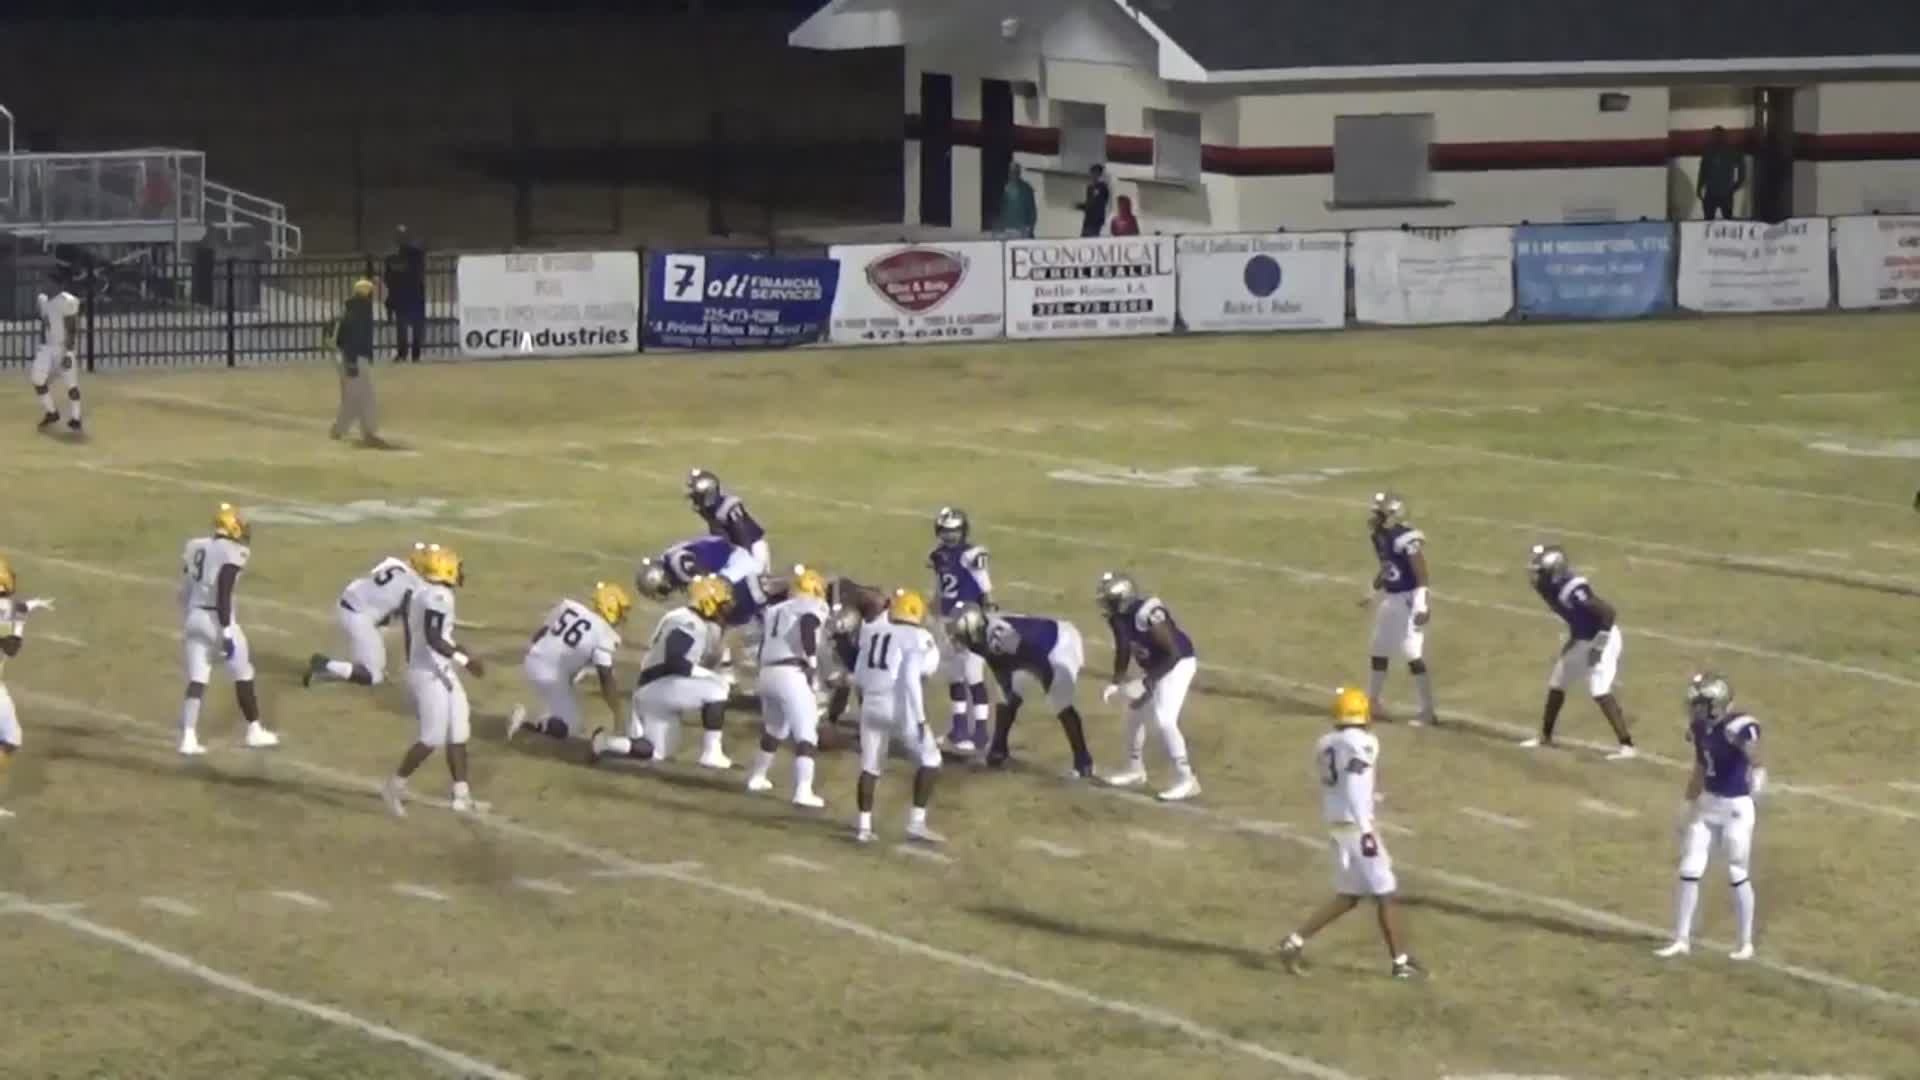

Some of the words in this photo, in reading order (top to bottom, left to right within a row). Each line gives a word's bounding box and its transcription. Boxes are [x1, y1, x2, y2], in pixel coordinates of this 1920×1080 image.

[1009, 243, 1172, 280] ECONOMICAL
[1032, 265, 1151, 280] WHOLESALE
[751, 276, 821, 289] FINANCIAL
[751, 288, 822, 300] SERVICES
[194, 548, 206, 582] 9
[374, 566, 406, 587] 5
[551, 608, 591, 648] 56
[868, 632, 892, 671] 11
